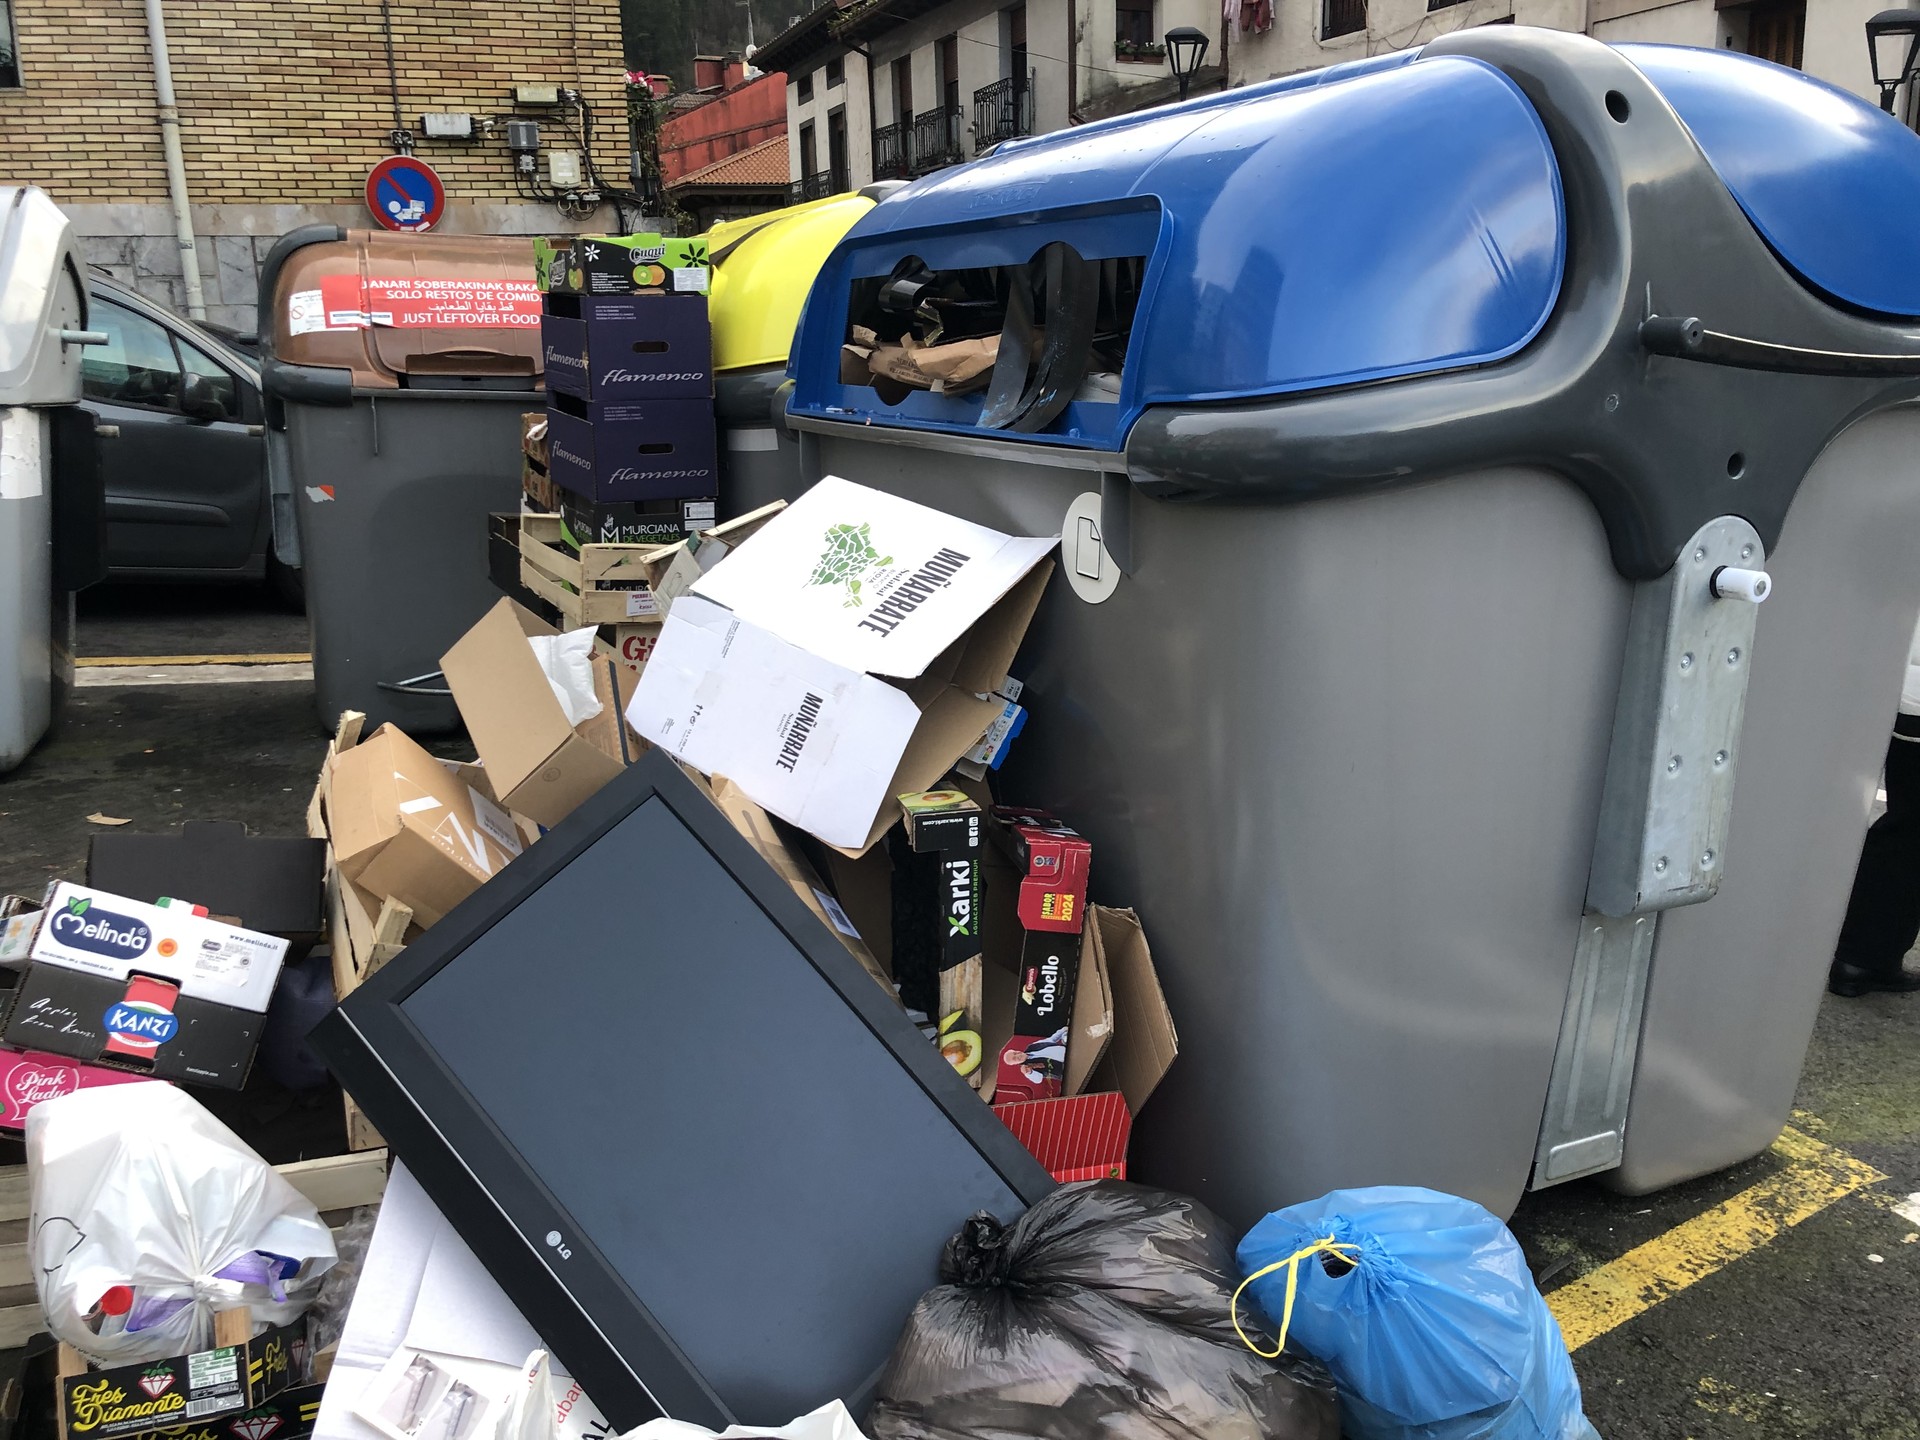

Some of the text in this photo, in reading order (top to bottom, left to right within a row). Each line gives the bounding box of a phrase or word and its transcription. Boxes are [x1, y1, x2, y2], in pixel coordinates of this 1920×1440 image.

[386, 290, 542, 302] SOLO RESTOS DE COMID
[414, 280, 504, 291] SOBERAKINAK
[402, 313, 433, 324] JUST
[436, 313, 499, 324] LEFTOVER
[503, 313, 540, 325] FOOD
[546, 345, 584, 369] flamenco
[601, 368, 704, 386] flamenco
[552, 439, 592, 470] flamenco
[608, 467, 709, 484] flamenco
[622, 523, 680, 535] MURCIANA
[623, 533, 680, 543] DE VEGETALES
[857, 547, 971, 638] MUÑARRATE
[775, 691, 824, 774] MUÑARRATE
[1041, 893, 1053, 916] SABOR
[1061, 894, 1075, 921] 2024
[56, 912, 147, 950] Melinda
[229, 934, 279, 951] www.melinda.it
[1036, 955, 1060, 1016] Lobello
[16, 1068, 66, 1091] Pink
[18, 1086, 67, 1105] Lady
[557, 1243, 572, 1260] LG
[72, 1379, 127, 1412] Fres
[72, 1392, 187, 1433] Diamante
